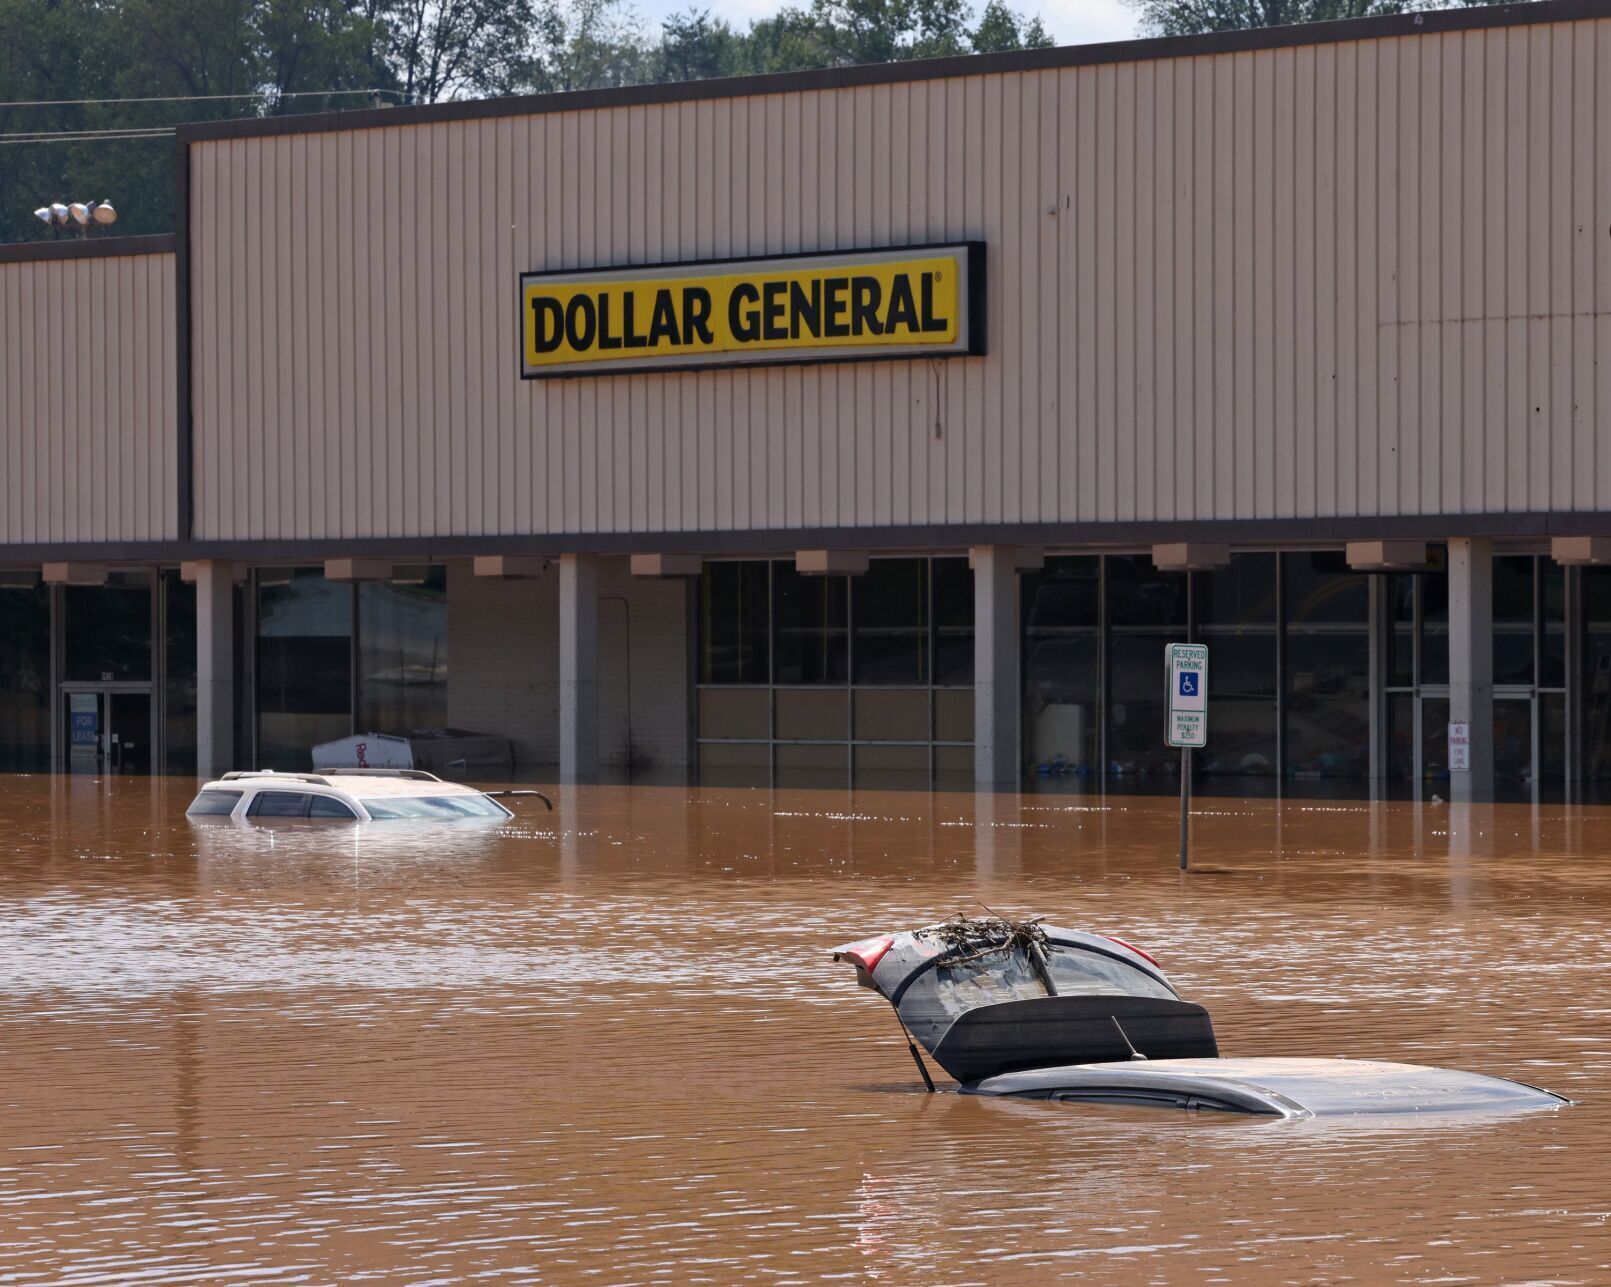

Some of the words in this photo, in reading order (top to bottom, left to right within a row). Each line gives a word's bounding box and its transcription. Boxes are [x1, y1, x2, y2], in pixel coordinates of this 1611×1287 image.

[531, 286, 714, 354] DOLLAR
[1173, 649, 1205, 659] RESERVED
[1176, 660, 1202, 670] PARKING
[76, 716, 92, 726] FOR
[1176, 723, 1199, 731] PENALTY
